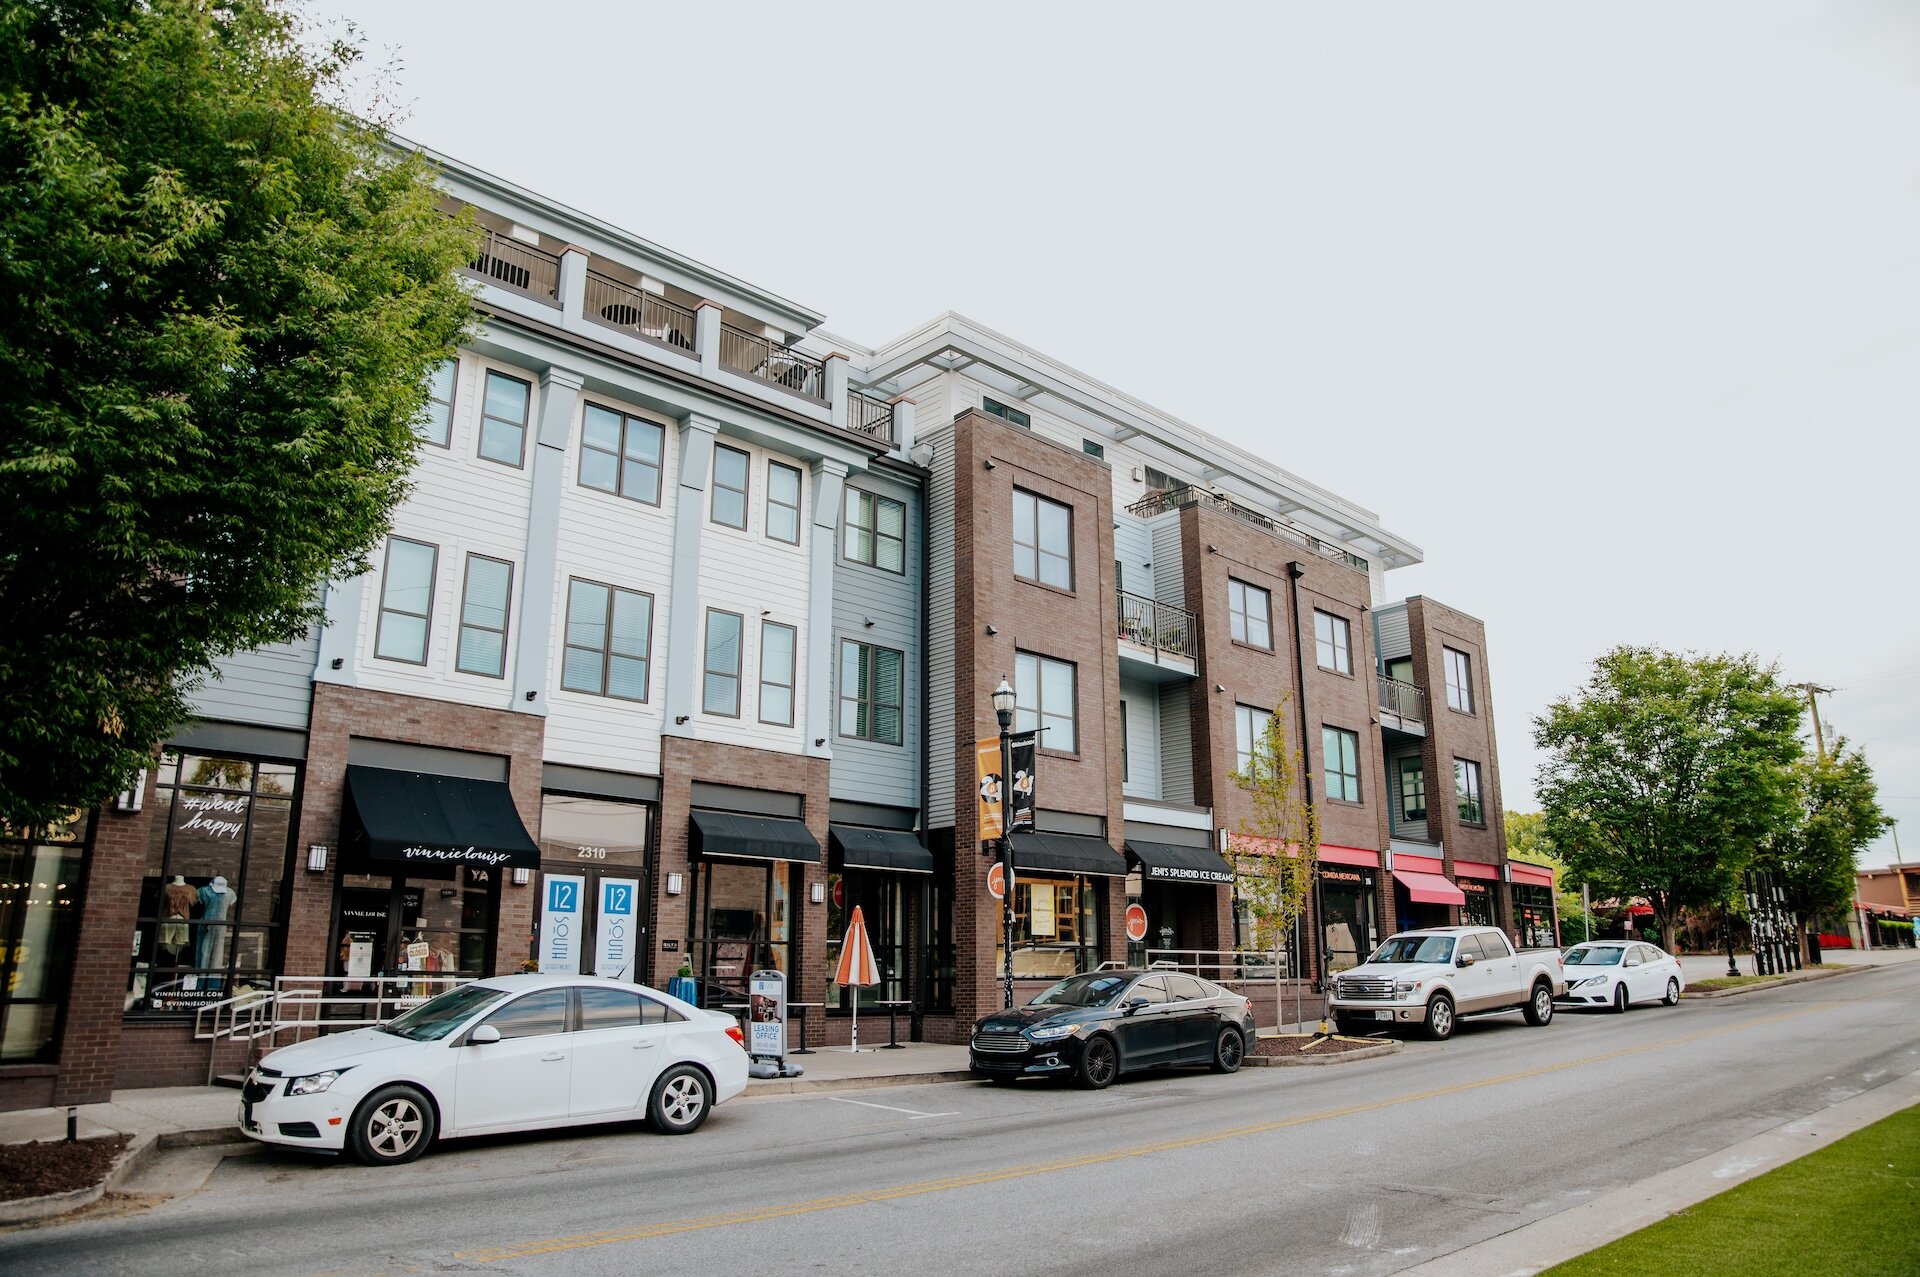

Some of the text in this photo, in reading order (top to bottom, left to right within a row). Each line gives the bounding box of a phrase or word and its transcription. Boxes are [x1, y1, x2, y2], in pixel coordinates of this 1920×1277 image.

[182, 797, 245, 815] #wear
[179, 810, 244, 839] happy
[402, 845, 511, 865] vinnielouise
[577, 846, 606, 859] 2310
[1151, 866, 1235, 882] JENI'S SPLENDID ICE CREAMS
[554, 884, 572, 909] 12
[610, 887, 627, 911] 12
[551, 916, 570, 959] SOUTH
[607, 918, 625, 960] SOUTH
[753, 1024, 779, 1033] LEASING
[755, 1032, 777, 1040] OFFICE
